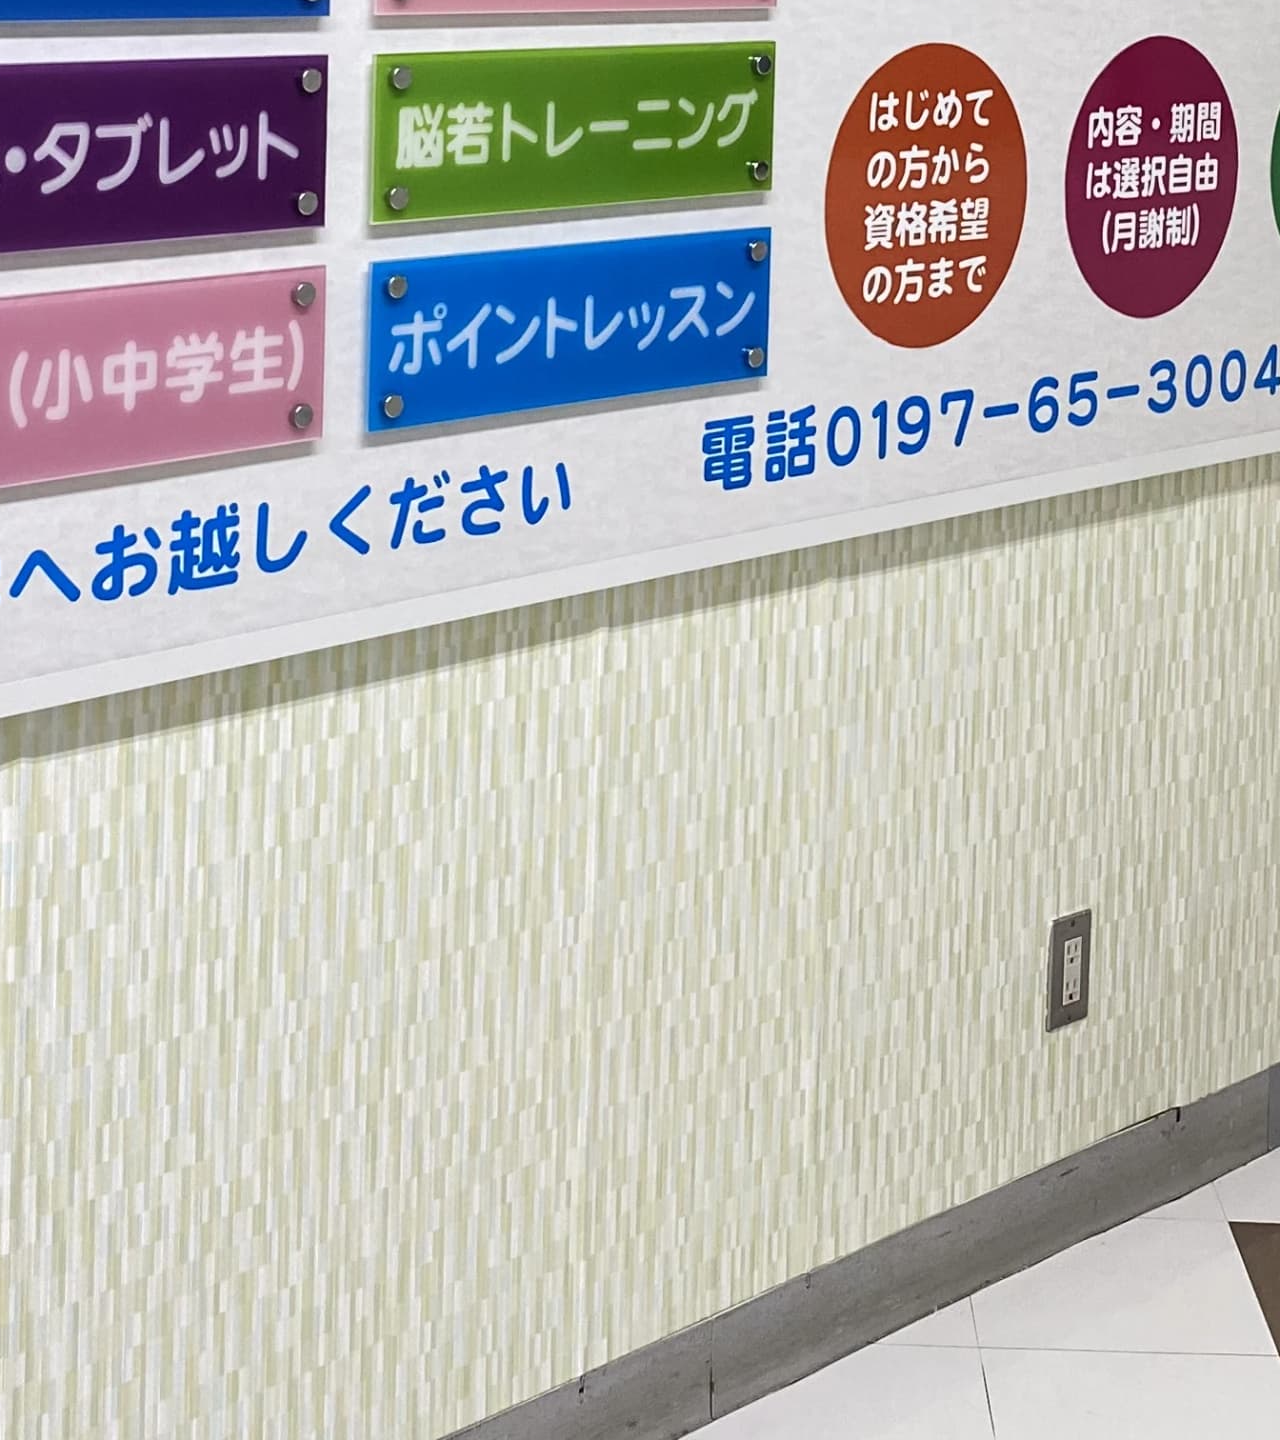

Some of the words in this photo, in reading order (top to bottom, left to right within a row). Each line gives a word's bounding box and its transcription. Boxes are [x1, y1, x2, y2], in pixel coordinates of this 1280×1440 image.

[397, 88, 759, 170] 脳若トレーニング
[869, 89, 993, 131] はじめて
[1088, 101, 1221, 150] 内容・期間
[867, 143, 990, 190] の方から
[1086, 153, 1218, 201] は選択自由
[864, 197, 989, 252] 資格希望
[862, 256, 987, 305] の方まで
[388, 280, 756, 376] ポイントレッスン
